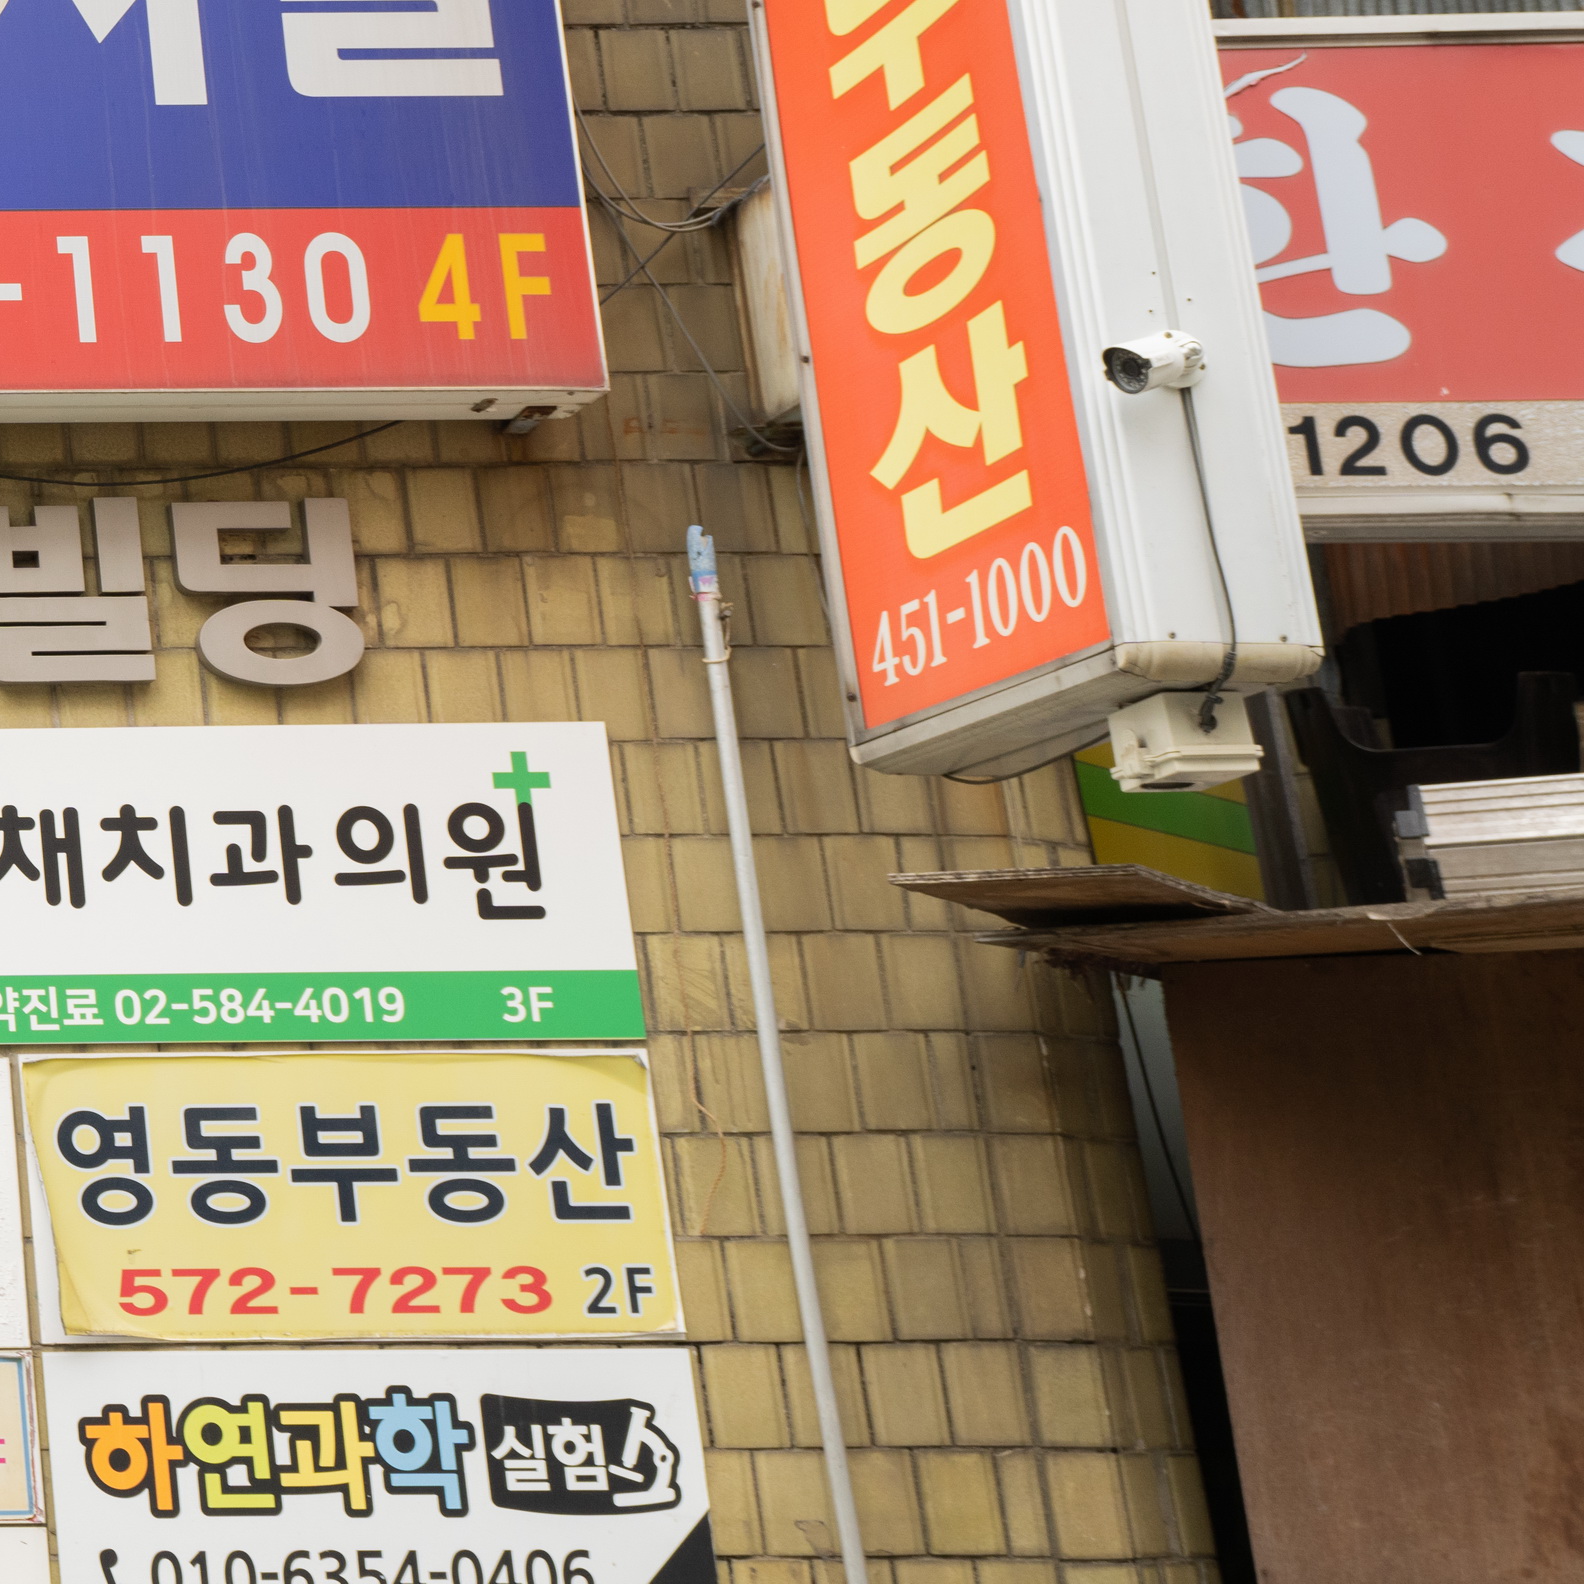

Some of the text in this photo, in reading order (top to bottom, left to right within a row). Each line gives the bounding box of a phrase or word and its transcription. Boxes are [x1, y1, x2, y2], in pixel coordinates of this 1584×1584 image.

[417, 232, 553, 342] 4F
[872, 525, 1088, 686] 451-1000
[113, 985, 406, 1028] 02-584-4019
[500, 985, 554, 1023] 3F
[56, 1100, 637, 1227] 영동부동산
[116, 1264, 657, 1318] 572-7273 2F
[82, 1390, 472, 1513] 하연과학
[150, 1548, 595, 1584] 010-6354-0406
